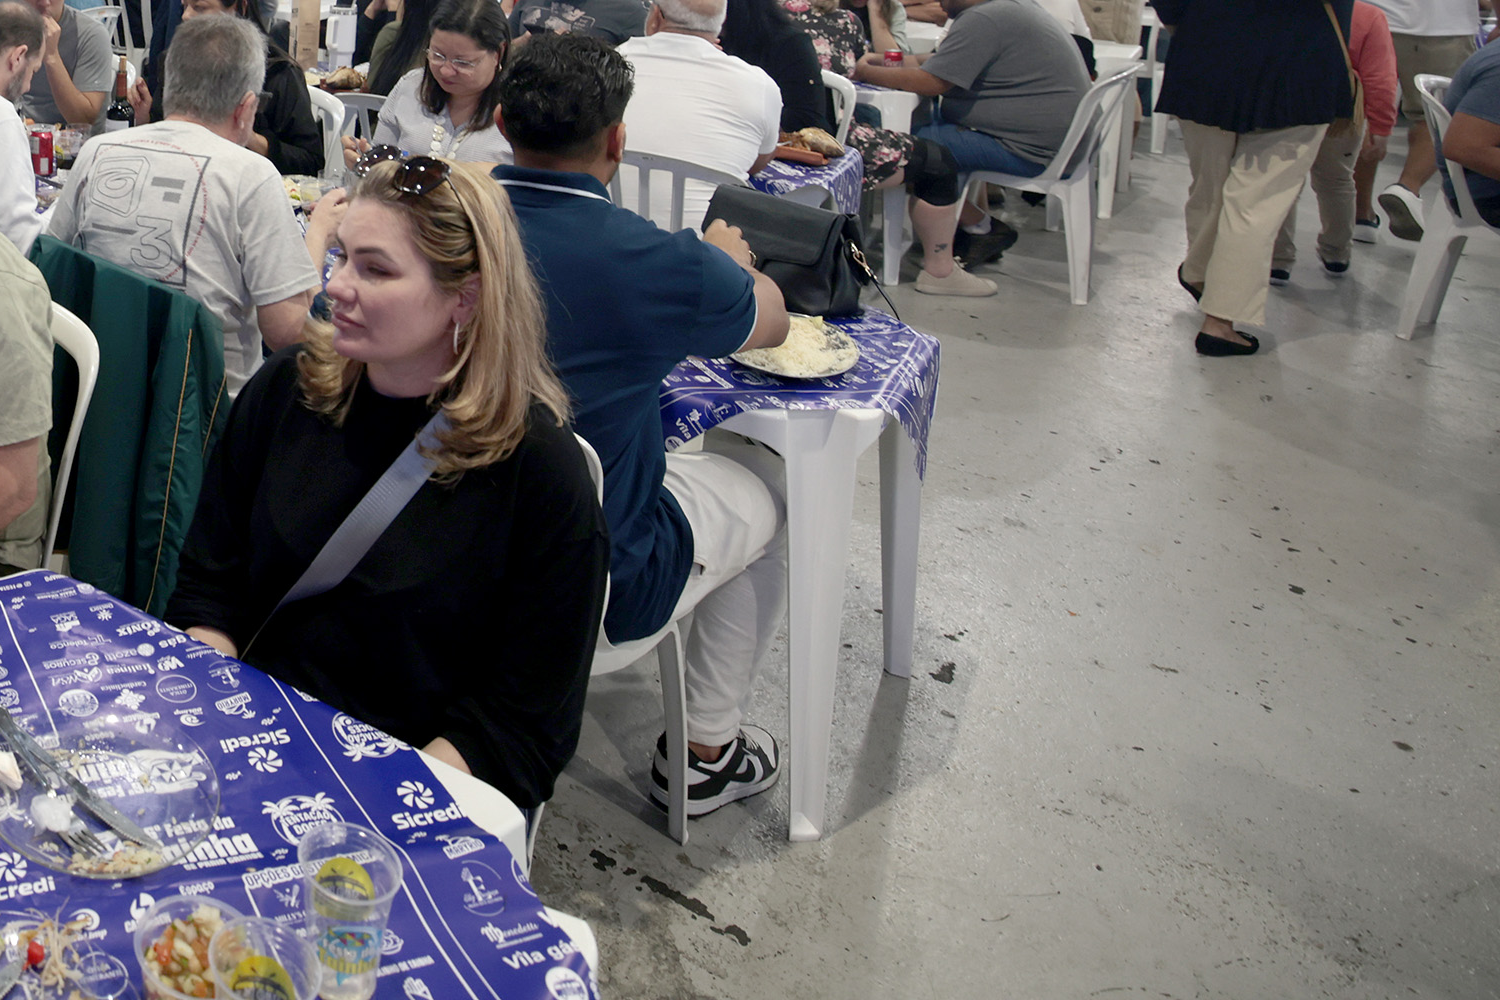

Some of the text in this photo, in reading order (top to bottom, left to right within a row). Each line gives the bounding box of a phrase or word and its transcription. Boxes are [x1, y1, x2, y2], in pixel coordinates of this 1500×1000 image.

[217, 693, 249, 709] MARYRIO
[220, 728, 291, 753] Sicredi
[212, 815, 235, 831] da
[391, 802, 468, 831] Sicredi
[245, 869, 290, 889] OPÇÕES
[179, 881, 214, 896] Espaço
